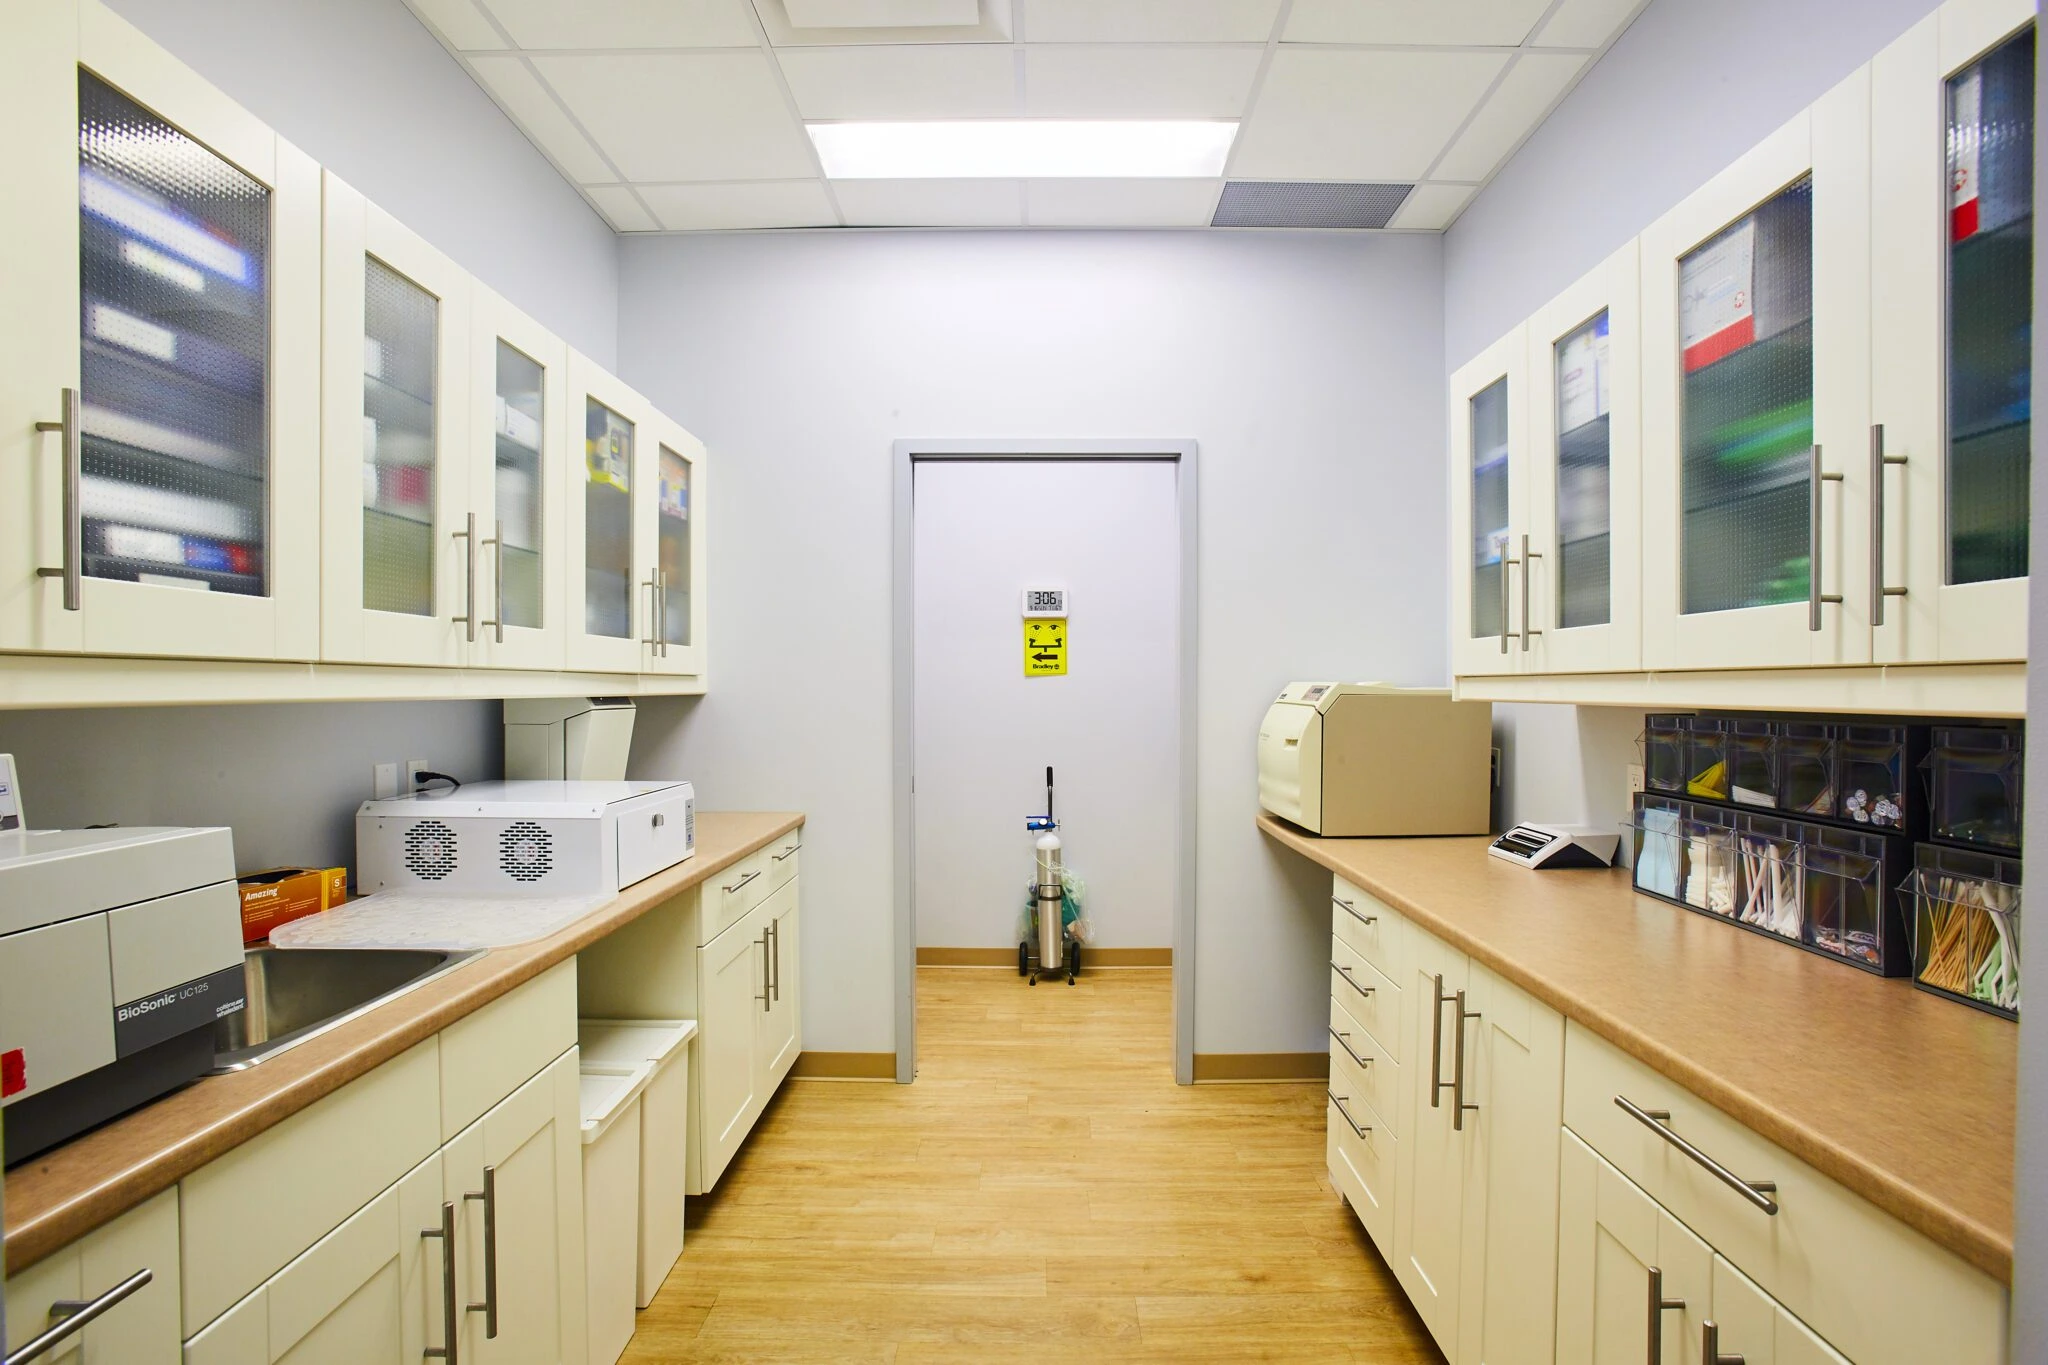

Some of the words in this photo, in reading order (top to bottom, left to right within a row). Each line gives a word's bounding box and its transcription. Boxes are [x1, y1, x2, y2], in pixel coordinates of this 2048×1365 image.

[334, 878, 340, 887] S
[245, 887, 279, 902] Amazing
[118, 994, 176, 1022] BioSonic
[179, 982, 209, 1000] UC125
